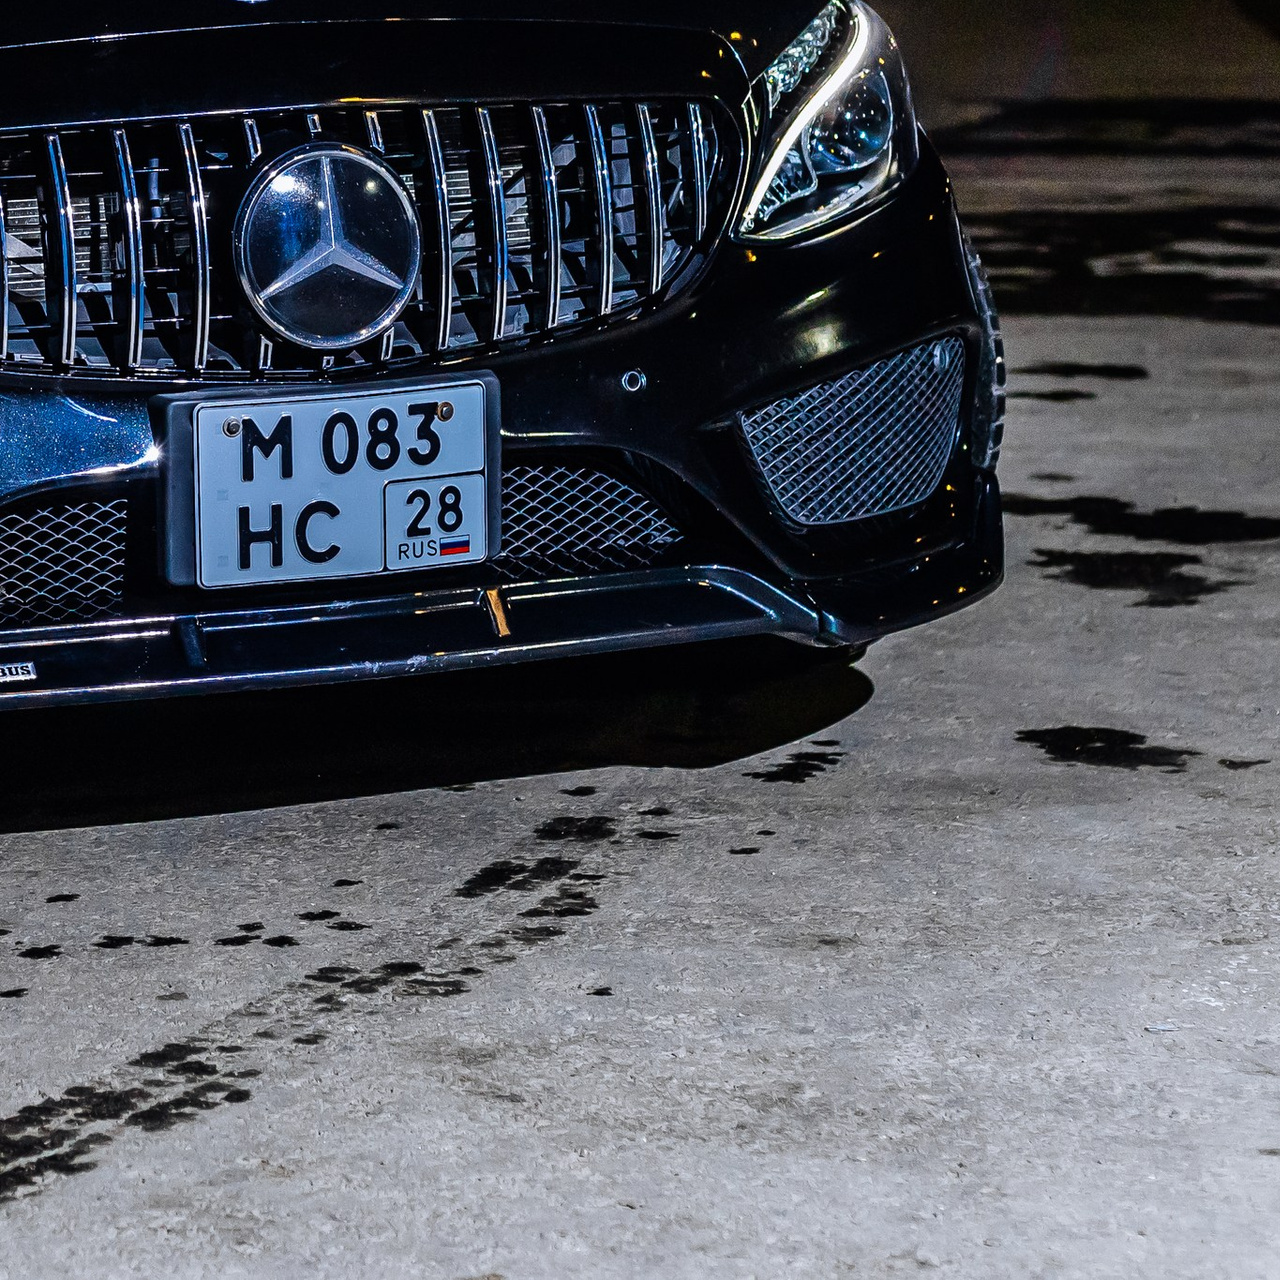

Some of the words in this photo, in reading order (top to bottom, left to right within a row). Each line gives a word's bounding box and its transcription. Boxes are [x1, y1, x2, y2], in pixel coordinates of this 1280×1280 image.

[241, 414, 293, 482] M
[322, 402, 441, 475] 083
[237, 500, 342, 570] HC
[406, 485, 463, 538] 28
[398, 539, 438, 561] RUS
